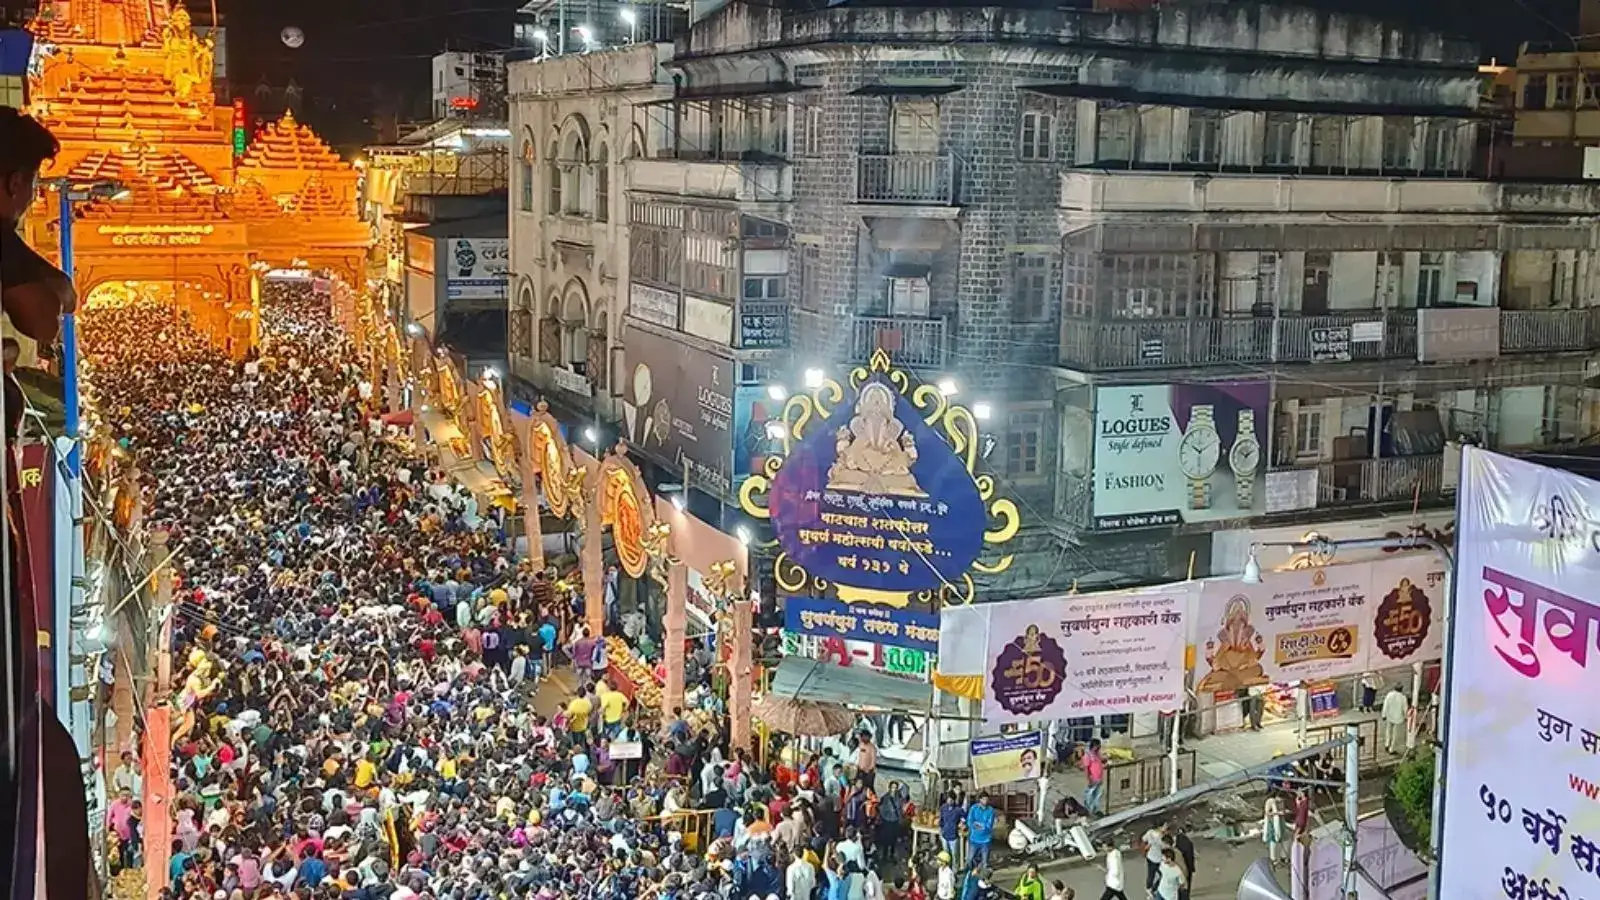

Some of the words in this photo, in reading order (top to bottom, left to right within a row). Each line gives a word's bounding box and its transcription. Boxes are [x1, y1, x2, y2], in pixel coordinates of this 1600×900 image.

[698, 385, 732, 413] LOGUES
[1102, 417, 1170, 434] LOGUES
[1107, 438, 1129, 455] Style
[1131, 437, 1162, 453] defined
[1105, 474, 1164, 490] FASHION
[799, 528, 829, 545] सुवर्ण
[1265, 600, 1306, 621] सुवर्णयुग
[1309, 595, 1345, 613] सहकारी
[1348, 592, 1365, 606] बँक
[800, 609, 856, 633] सुवर्णयुग
[863, 617, 899, 636] तरुण
[1060, 613, 1110, 637] सुवर्णयुग
[1113, 611, 1158, 631] सहकारी
[1160, 609, 1182, 626] बँक
[1537, 708, 1573, 742] युग
[1580, 728, 1600, 755] स
[1569, 773, 1600, 801] ww
[1479, 783, 1512, 824] ५०
[1522, 807, 1568, 855] वर्षे
[1570, 833, 1600, 880] स
